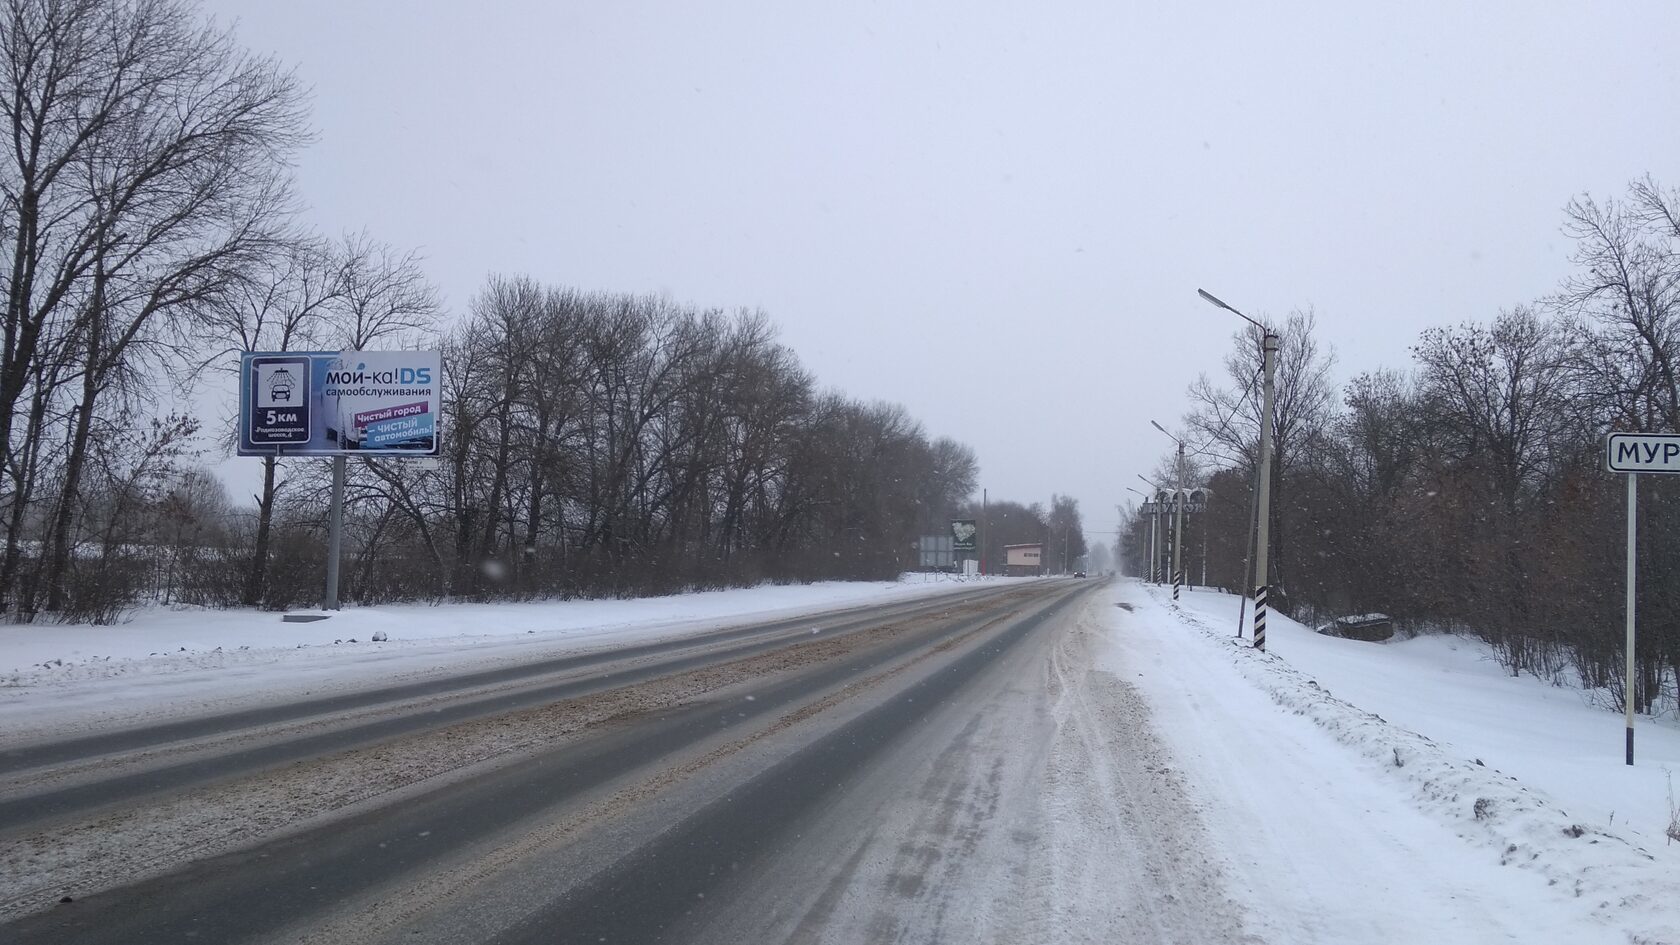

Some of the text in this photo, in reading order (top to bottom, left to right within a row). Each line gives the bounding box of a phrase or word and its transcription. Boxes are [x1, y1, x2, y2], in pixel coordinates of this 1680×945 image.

[326, 387, 431, 398] самообслуживания
[266, 410, 297, 425] 5 км
[357, 405, 421, 422] Чистый город
[374, 425, 432, 442] автомобиль!
[1617, 442, 1680, 464] МУР
